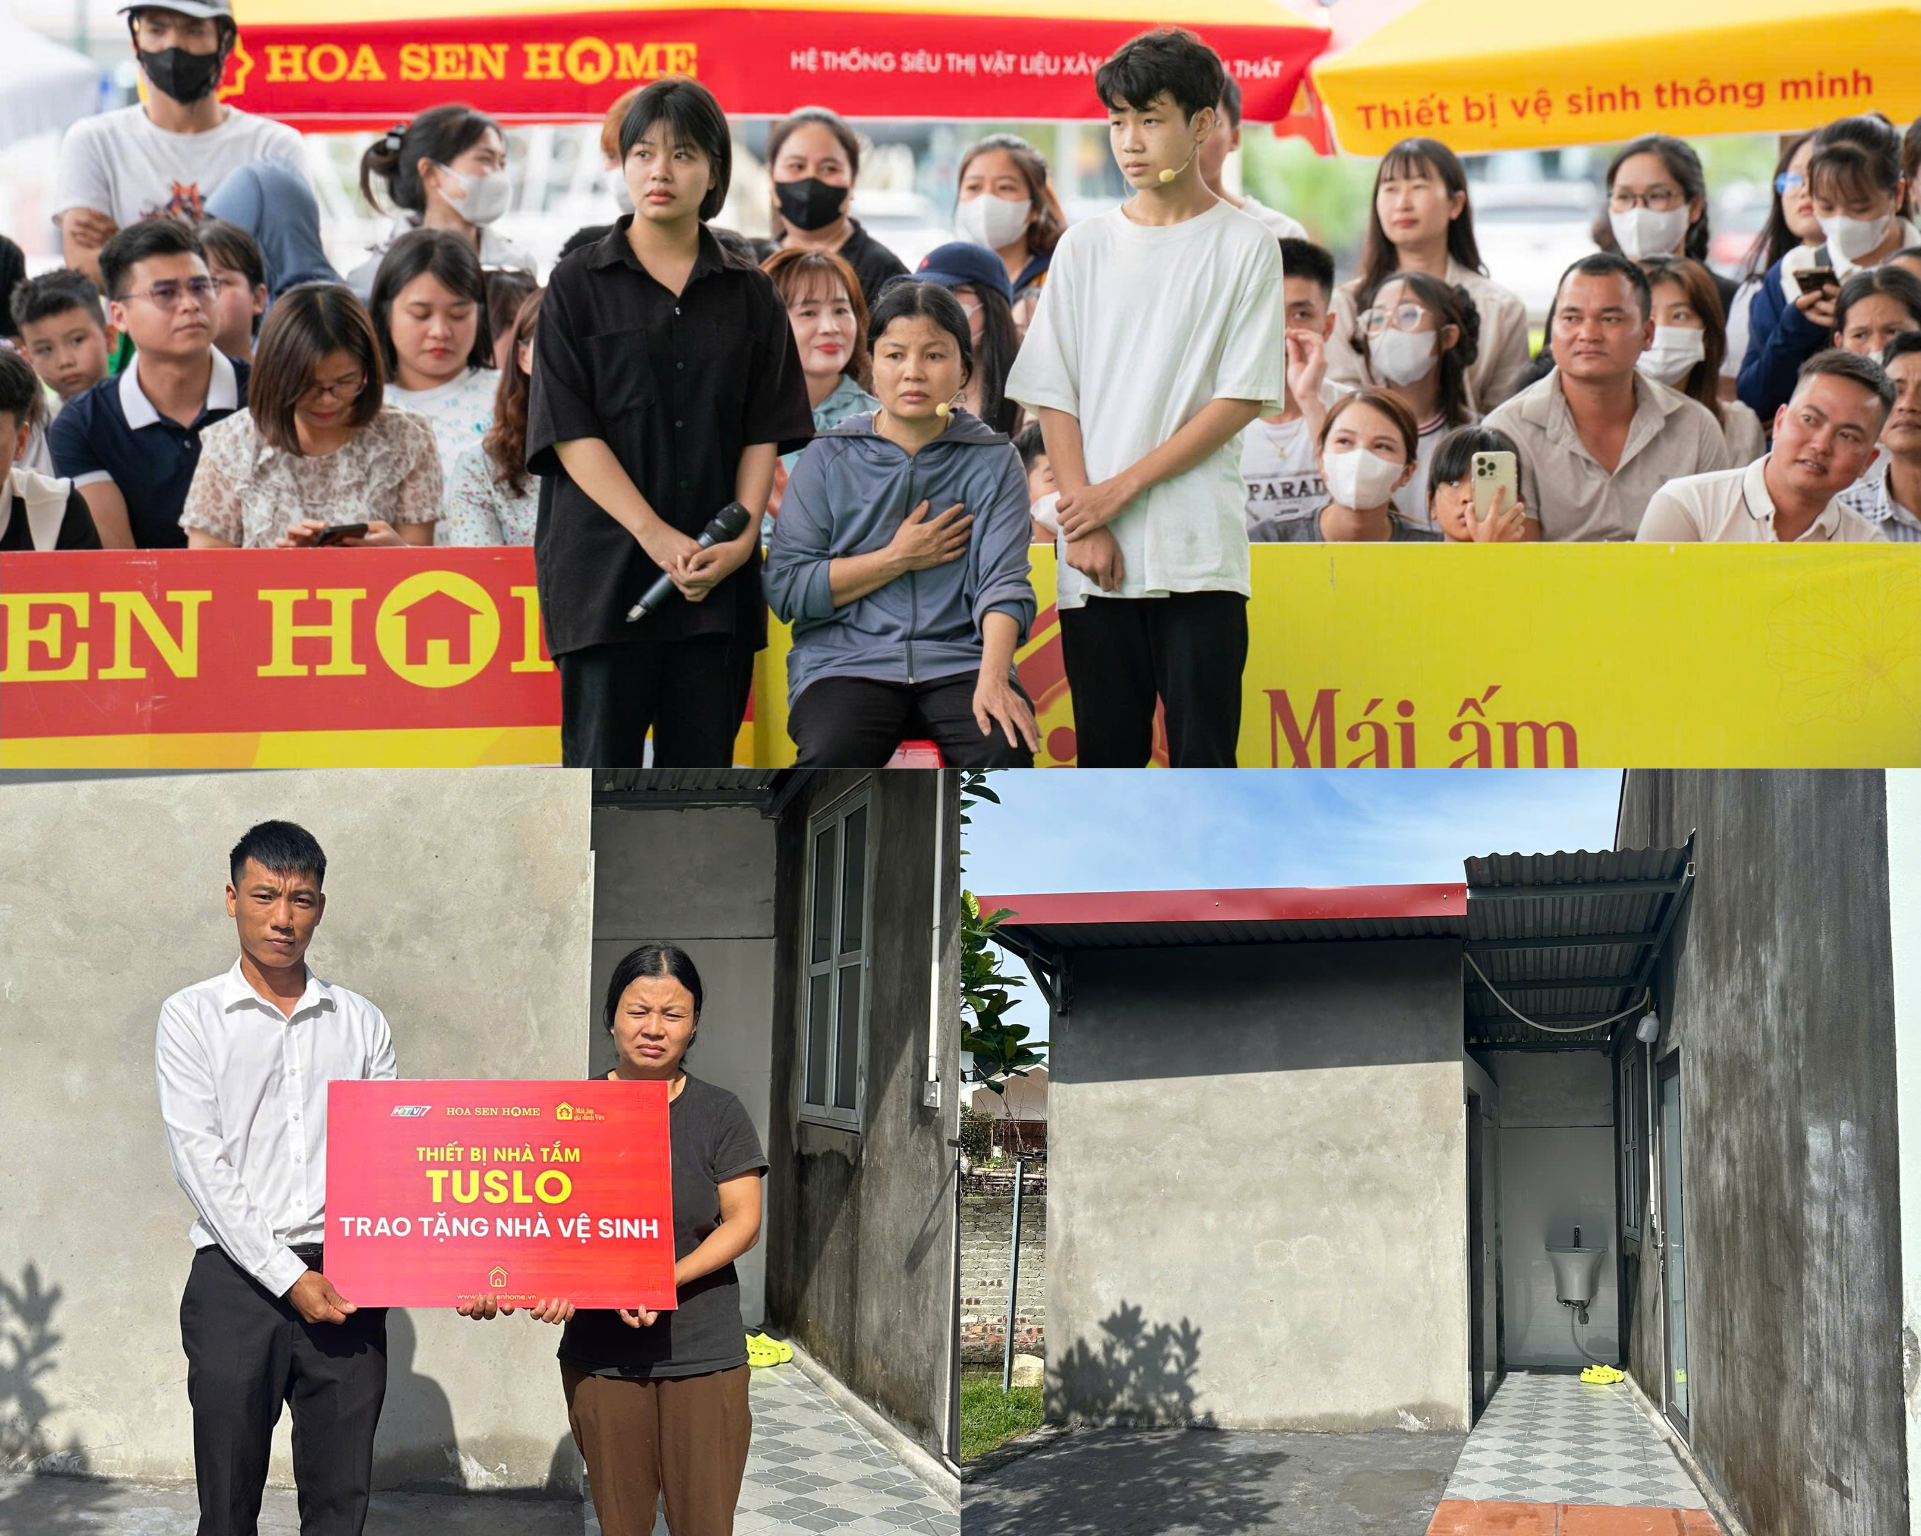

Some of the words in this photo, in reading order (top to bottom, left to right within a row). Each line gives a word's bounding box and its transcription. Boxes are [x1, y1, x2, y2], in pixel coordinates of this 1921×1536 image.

[265, 44, 385, 82] HOA
[400, 43, 509, 81] SEN
[523, 37, 697, 84] HOME
[790, 46, 818, 74] HỆ
[820, 46, 896, 72] THỐNG
[901, 49, 941, 73] SIÊU
[945, 53, 976, 77] THỊ
[980, 50, 1017, 77] VẬT
[1020, 51, 1060, 78] LIỆU
[1062, 52, 1099, 76] XÂY
[1233, 56, 1283, 78] THẤT
[1357, 92, 1450, 130] Thiết
[1464, 94, 1498, 129] bị
[1511, 89, 1553, 124] vệ
[1567, 84, 1641, 115] sinh
[1654, 77, 1765, 109] thông
[1780, 69, 1874, 101] minh
[0, 590, 212, 683] EN
[1262, 688, 1416, 768] Mái
[1448, 685, 1578, 768] ấm
[391, 1105, 432, 1117] HTV7
[446, 1107, 472, 1116] HOA
[474, 1107, 498, 1116] SEN
[501, 1106, 541, 1117] HOME
[416, 1141, 465, 1162] THIẾT
[470, 1147, 487, 1166] BỊ
[494, 1144, 534, 1163] NHÀ
[540, 1141, 581, 1163] TẮM
[425, 1169, 572, 1204] TUSLO
[339, 1217, 411, 1237] TRAO
[418, 1212, 489, 1243] TẶNG
[495, 1210, 551, 1238] NHÀ
[556, 1212, 591, 1244] VỆ
[597, 1218, 659, 1239] SINH
